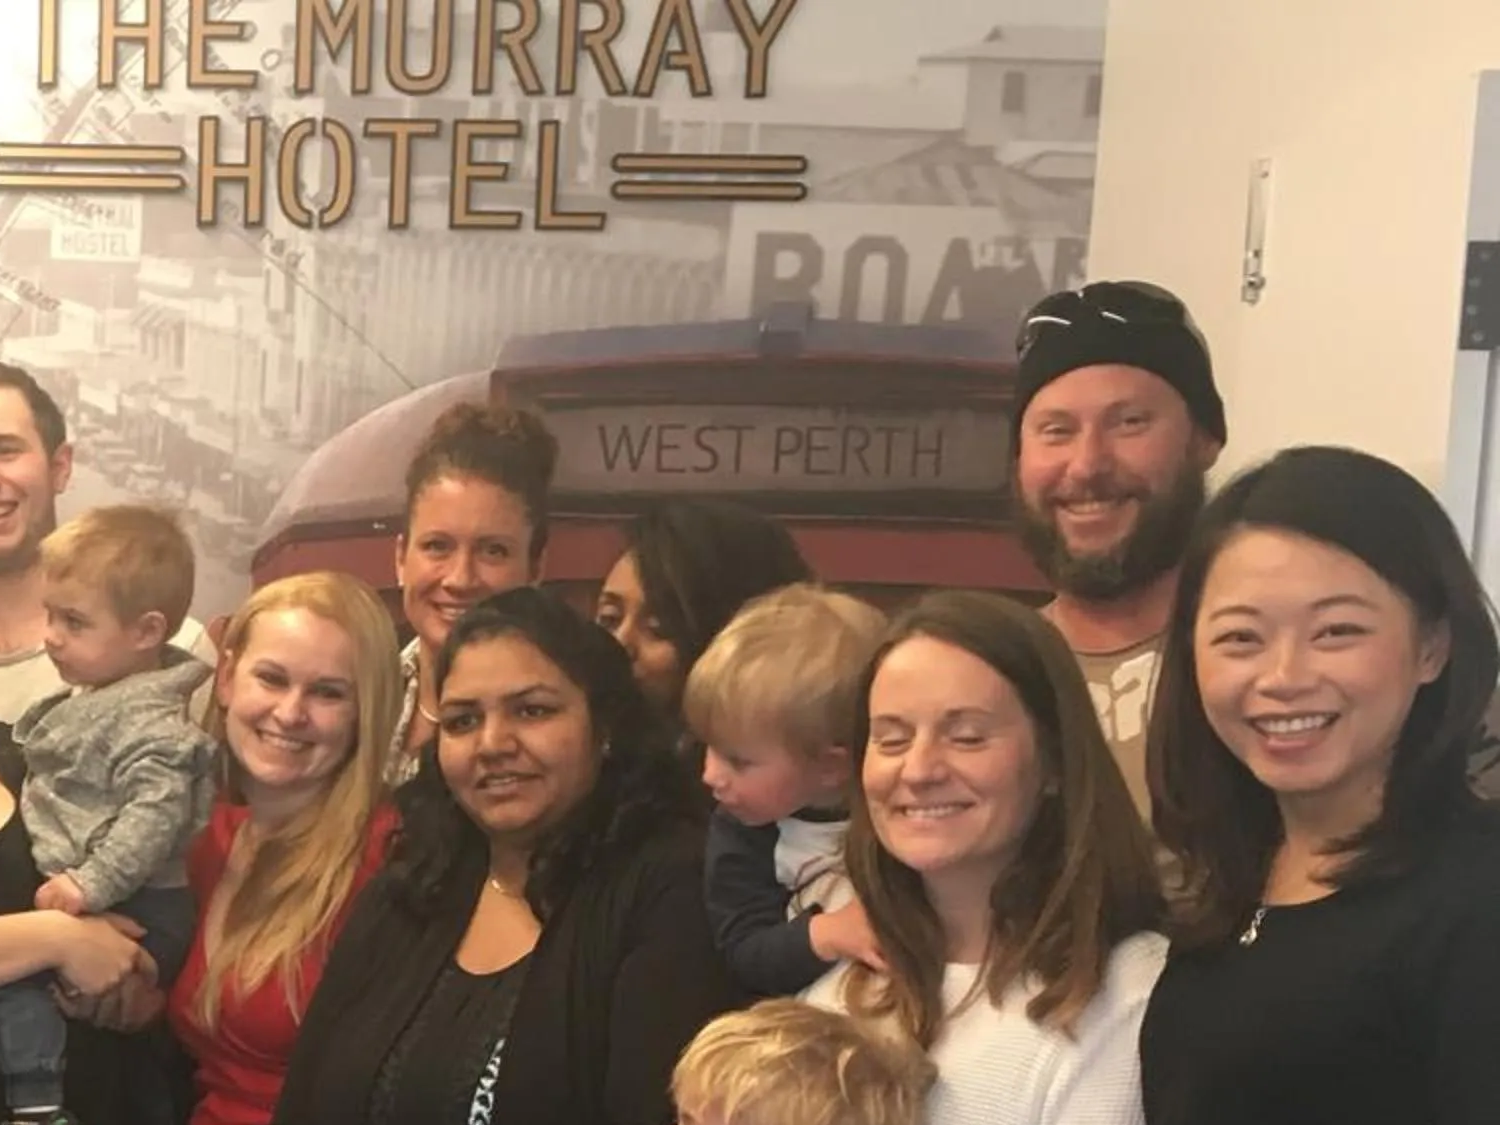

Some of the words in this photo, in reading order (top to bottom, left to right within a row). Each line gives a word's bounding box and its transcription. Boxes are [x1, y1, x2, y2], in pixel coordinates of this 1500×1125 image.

[294, 0, 798, 98] MURRAY
[197, 115, 607, 231] HOTEL
[597, 423, 756, 475] WEST
[771, 424, 945, 478] PERTH
